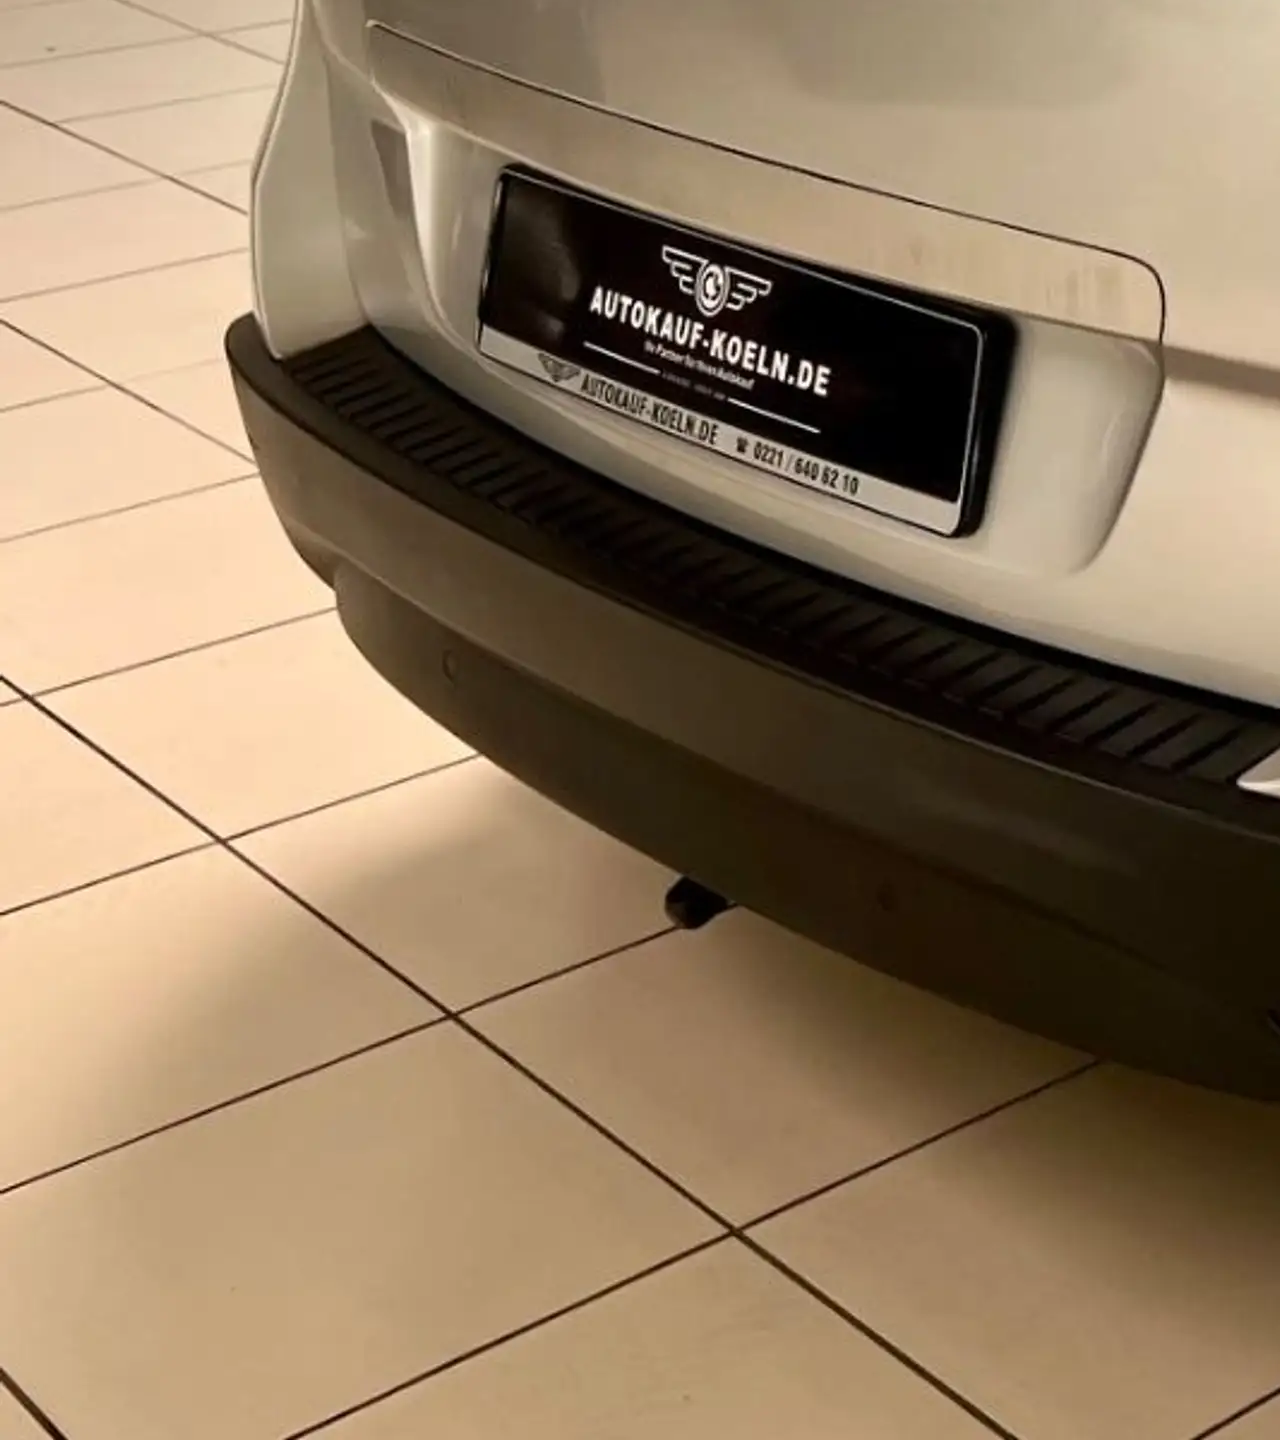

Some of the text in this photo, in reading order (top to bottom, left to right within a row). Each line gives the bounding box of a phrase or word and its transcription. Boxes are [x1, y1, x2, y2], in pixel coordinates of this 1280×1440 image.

[589, 285, 832, 398] AUTOKAUF-KOELN.DE
[580, 374, 720, 446] AUTOKAUF-KOELN.DE
[754, 441, 784, 469] 0221
[842, 474, 860, 496] 10
